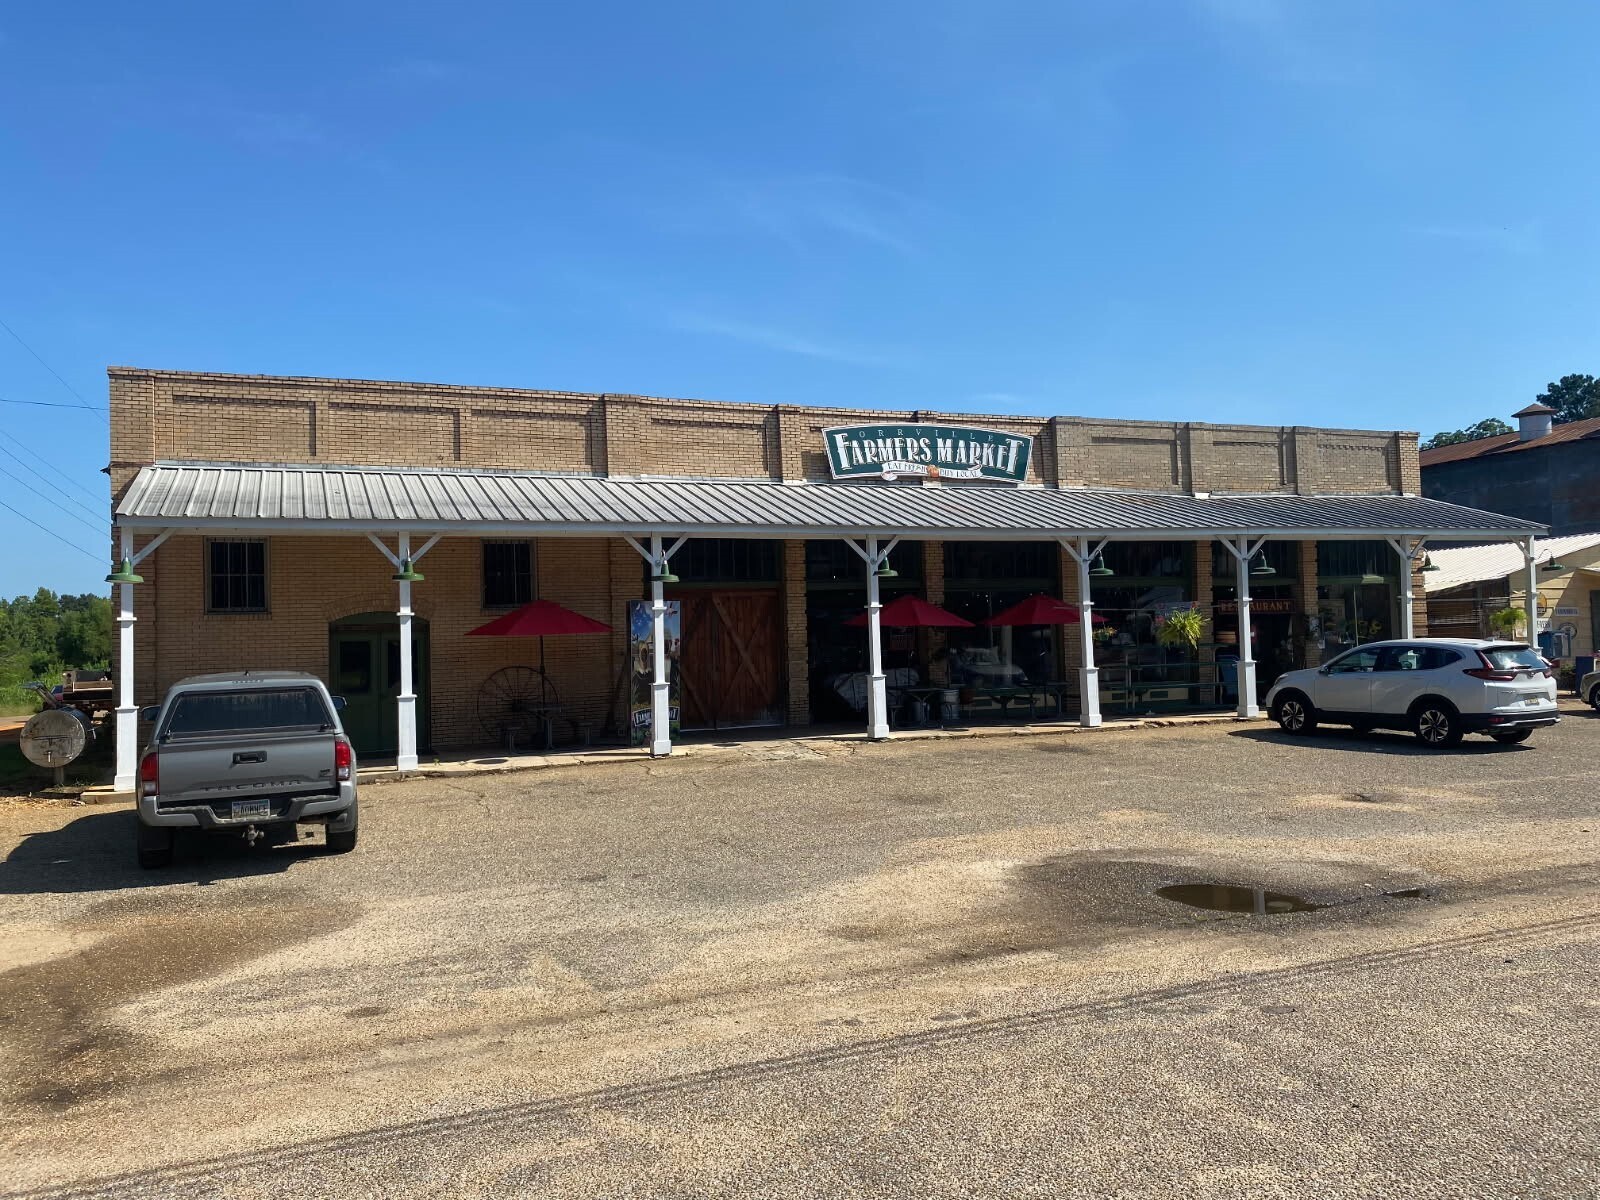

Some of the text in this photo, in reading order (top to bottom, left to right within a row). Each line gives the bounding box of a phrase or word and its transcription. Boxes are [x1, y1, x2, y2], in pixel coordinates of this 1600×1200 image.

[858, 428, 993, 442] ORRVILLE
[832, 432, 1025, 476] FARMERS MARKET
